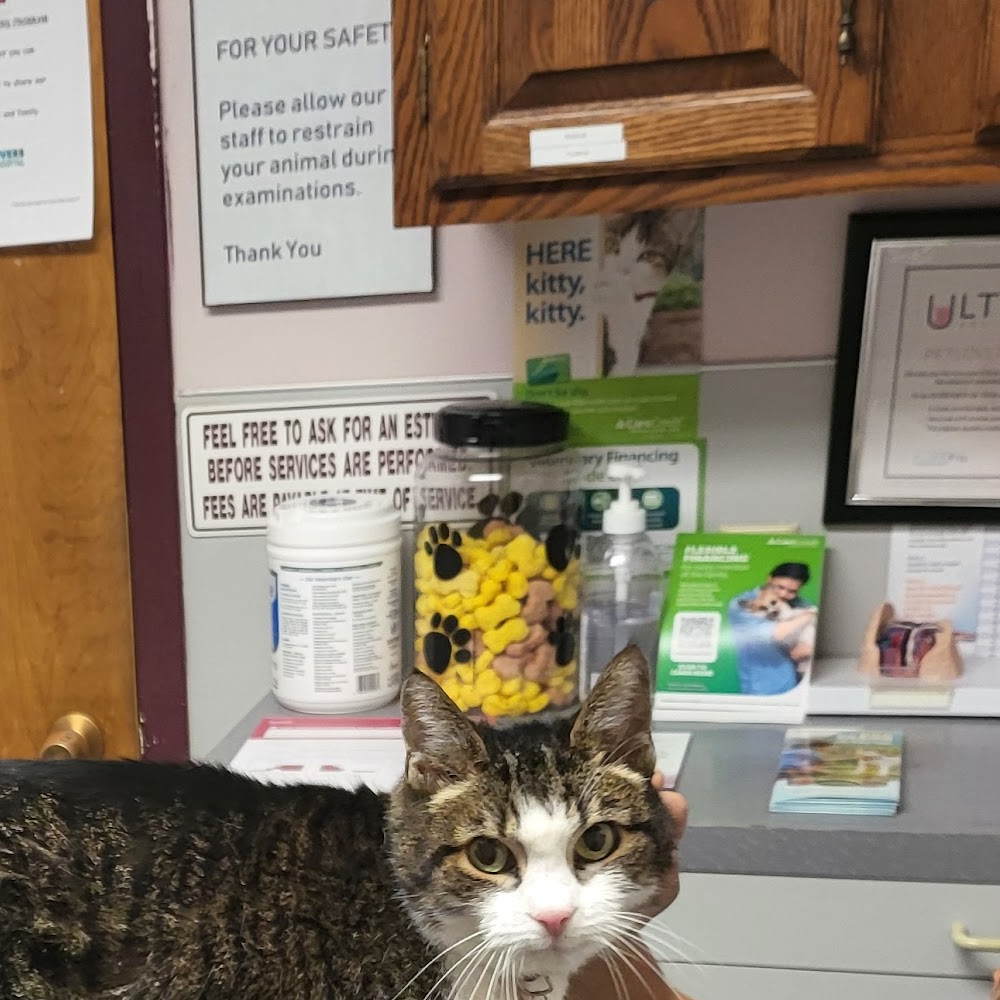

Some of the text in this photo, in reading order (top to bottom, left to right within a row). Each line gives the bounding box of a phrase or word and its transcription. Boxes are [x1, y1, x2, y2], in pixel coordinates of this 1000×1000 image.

[216, 36, 258, 61] FOR
[261, 30, 317, 57] YOUR
[219, 88, 386, 120] Please allow our
[220, 117, 374, 150] staff to restrain
[221, 160, 265, 184] your
[270, 151, 337, 175] animal
[222, 180, 361, 208] examinations.
[223, 240, 323, 264] Thank You
[526, 238, 592, 266] HERE
[526, 271, 586, 299] kitty,
[526, 301, 585, 328] kitty.
[203, 423, 237, 450] FEEL
[243, 420, 278, 448] FREE
[284, 419, 302, 446] TO
[308, 417, 337, 444] ASK
[343, 415, 371, 443] FOR
[378, 413, 398, 441] AN
[208, 456, 262, 483] BEFORE
[269, 452, 337, 480] SERVICES
[343, 451, 371, 478] ARE
[607, 449, 679, 465] Financing
[203, 494, 236, 520] FEES
[242, 493, 267, 519] ARE
[393, 487, 411, 512] OF
